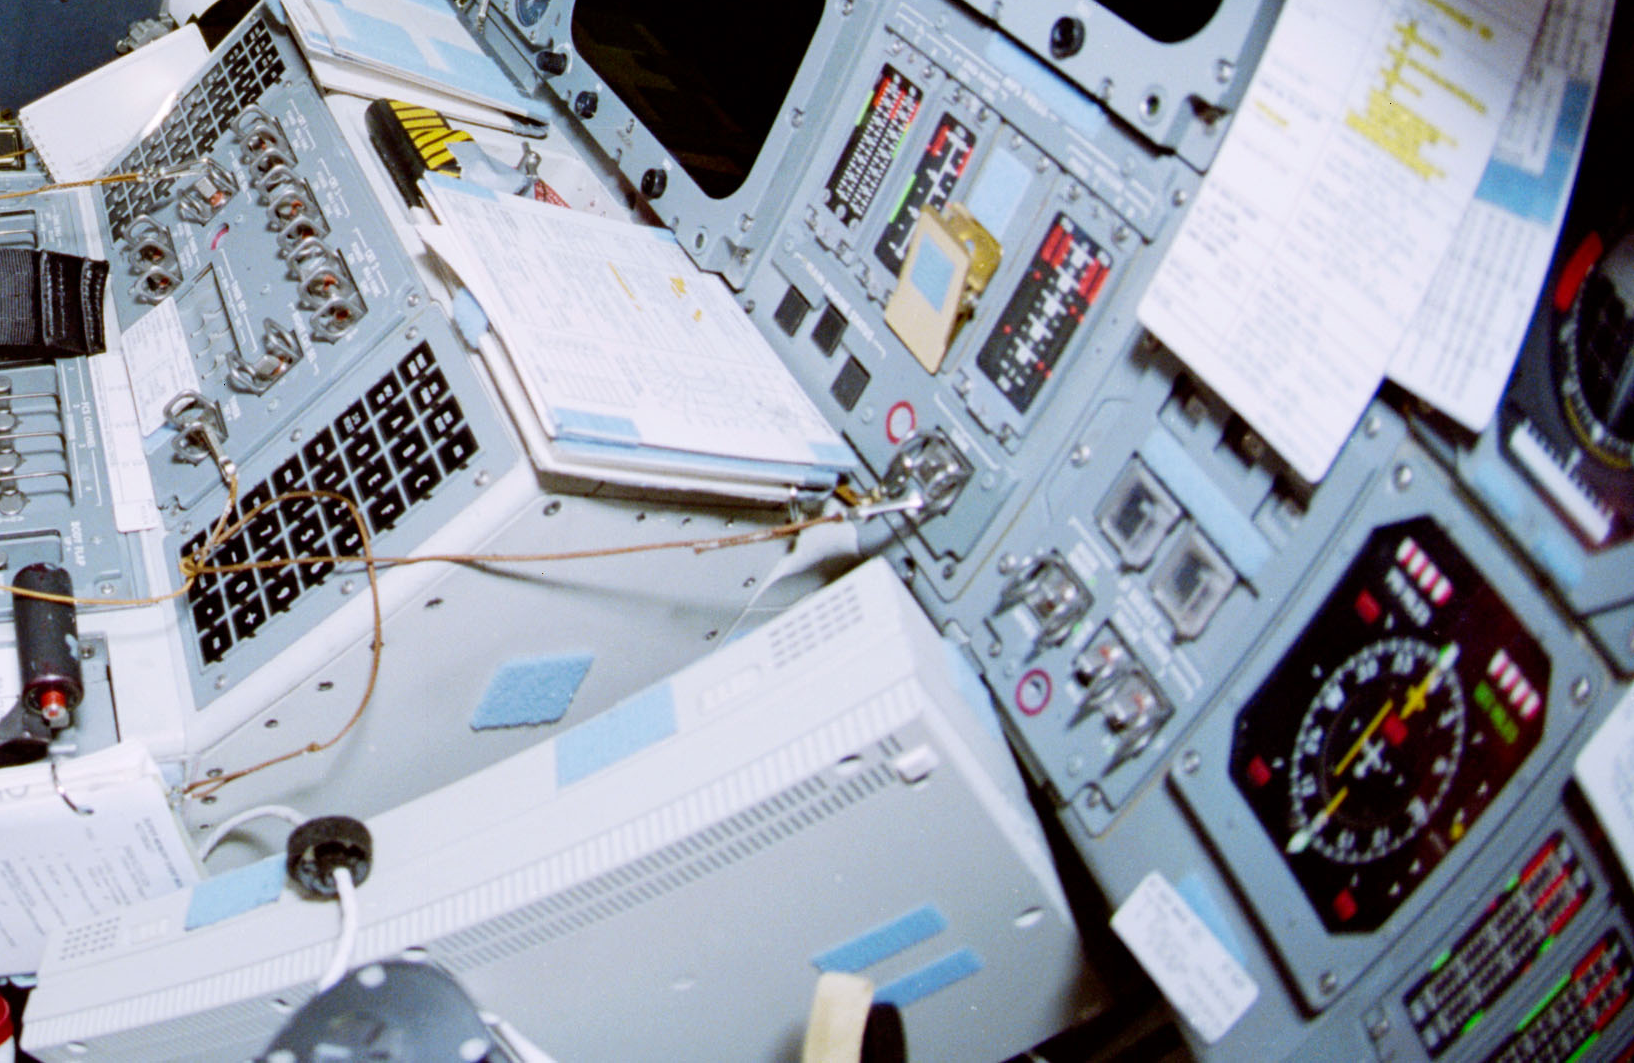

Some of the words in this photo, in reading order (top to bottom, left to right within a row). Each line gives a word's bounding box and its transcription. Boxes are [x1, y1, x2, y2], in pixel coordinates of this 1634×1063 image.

[81, 401, 90, 414] FCS
[390, 415, 404, 429] A
[83, 416, 95, 449] CHANNEL
[415, 474, 430, 488] C
[334, 501, 348, 516] 2
[70, 521, 83, 543] BODY
[259, 525, 273, 536] 7
[300, 528, 315, 541] 5
[344, 532, 360, 548] 3
[74, 546, 87, 566] FLAP
